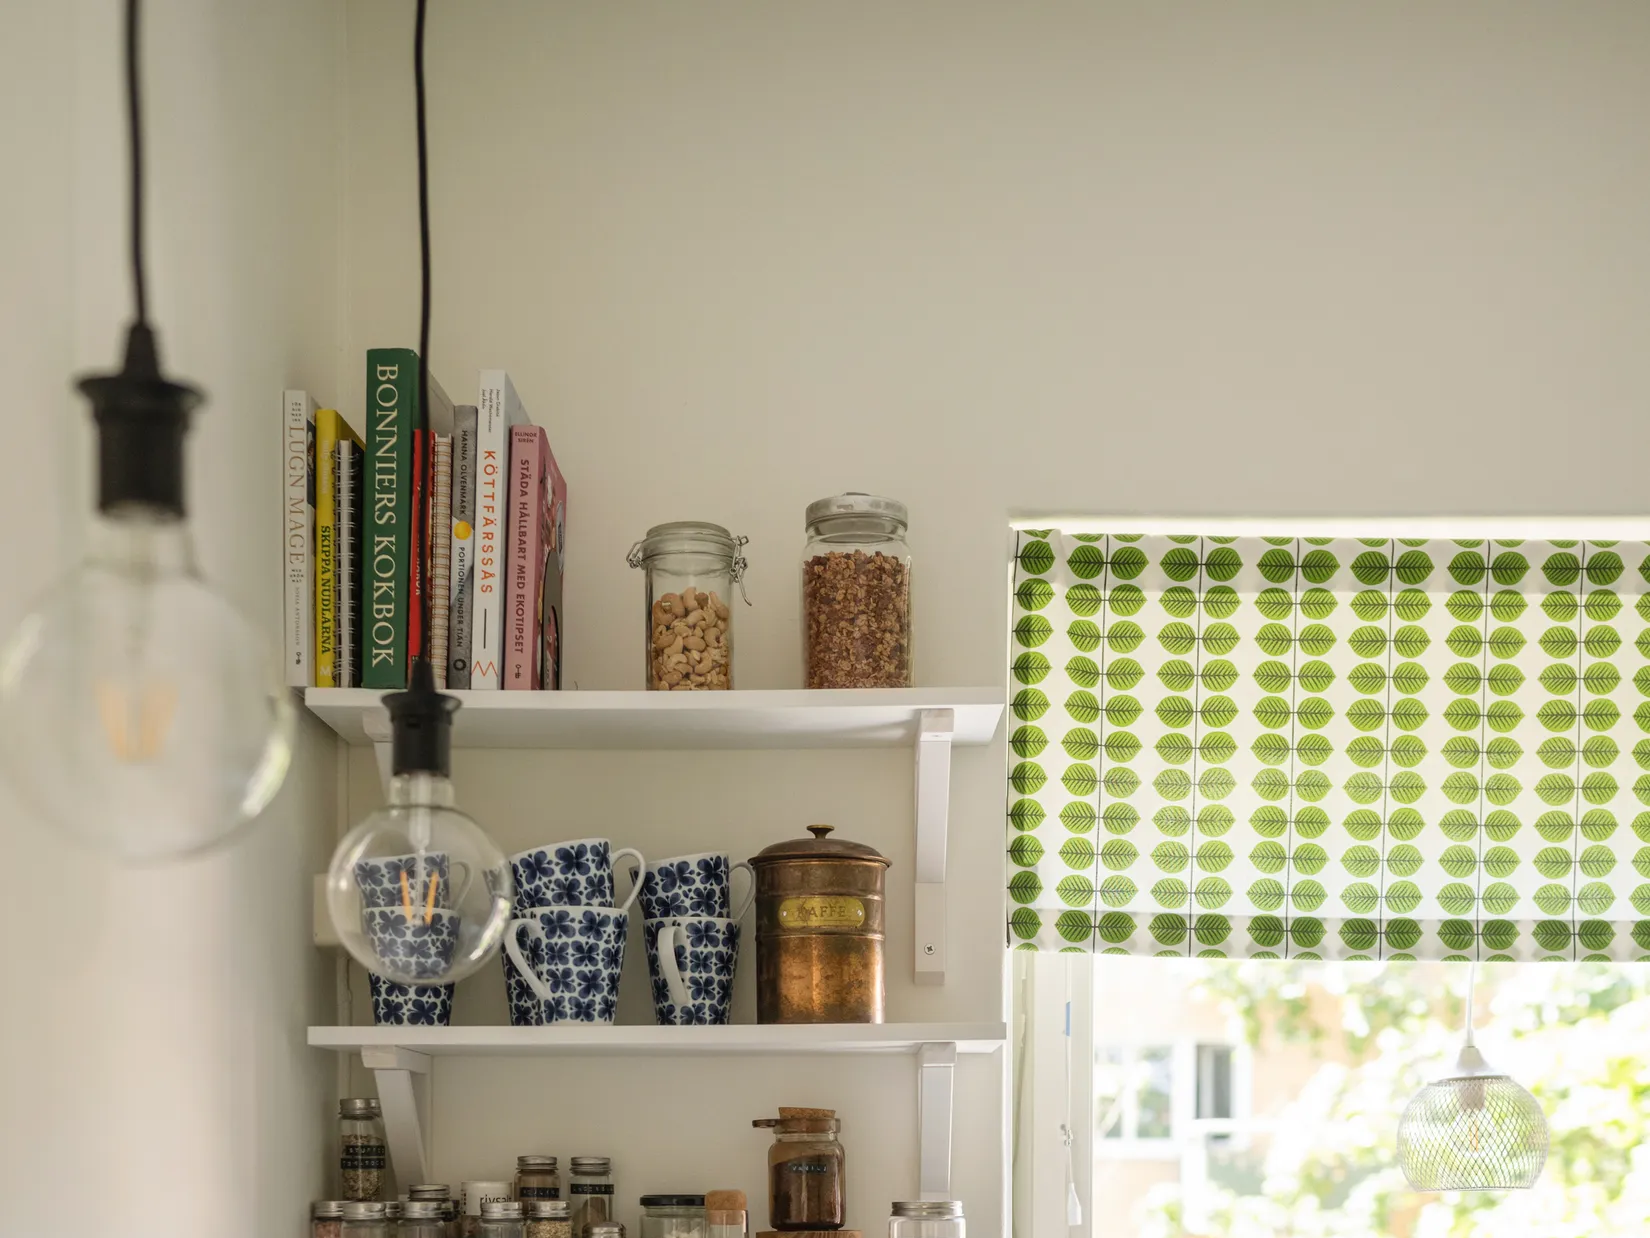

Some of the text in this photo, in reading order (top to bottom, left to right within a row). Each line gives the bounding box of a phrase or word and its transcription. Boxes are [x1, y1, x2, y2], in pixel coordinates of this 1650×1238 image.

[289, 426, 305, 564] LUGN MAGE
[372, 364, 399, 672] BONNIERS KOKBOK
[460, 430, 468, 515] HANNA OLVENMARK
[481, 450, 498, 593] KÖTTFÄRSSÅS
[321, 525, 331, 655] SKIPPA NUDLARNA
[456, 546, 466, 648] PORTIONEN UNDER TIAN
[515, 459, 532, 654] STÄDA HÅLLBART MED EKOTIPSET
[797, 905, 846, 918] KAFFE
